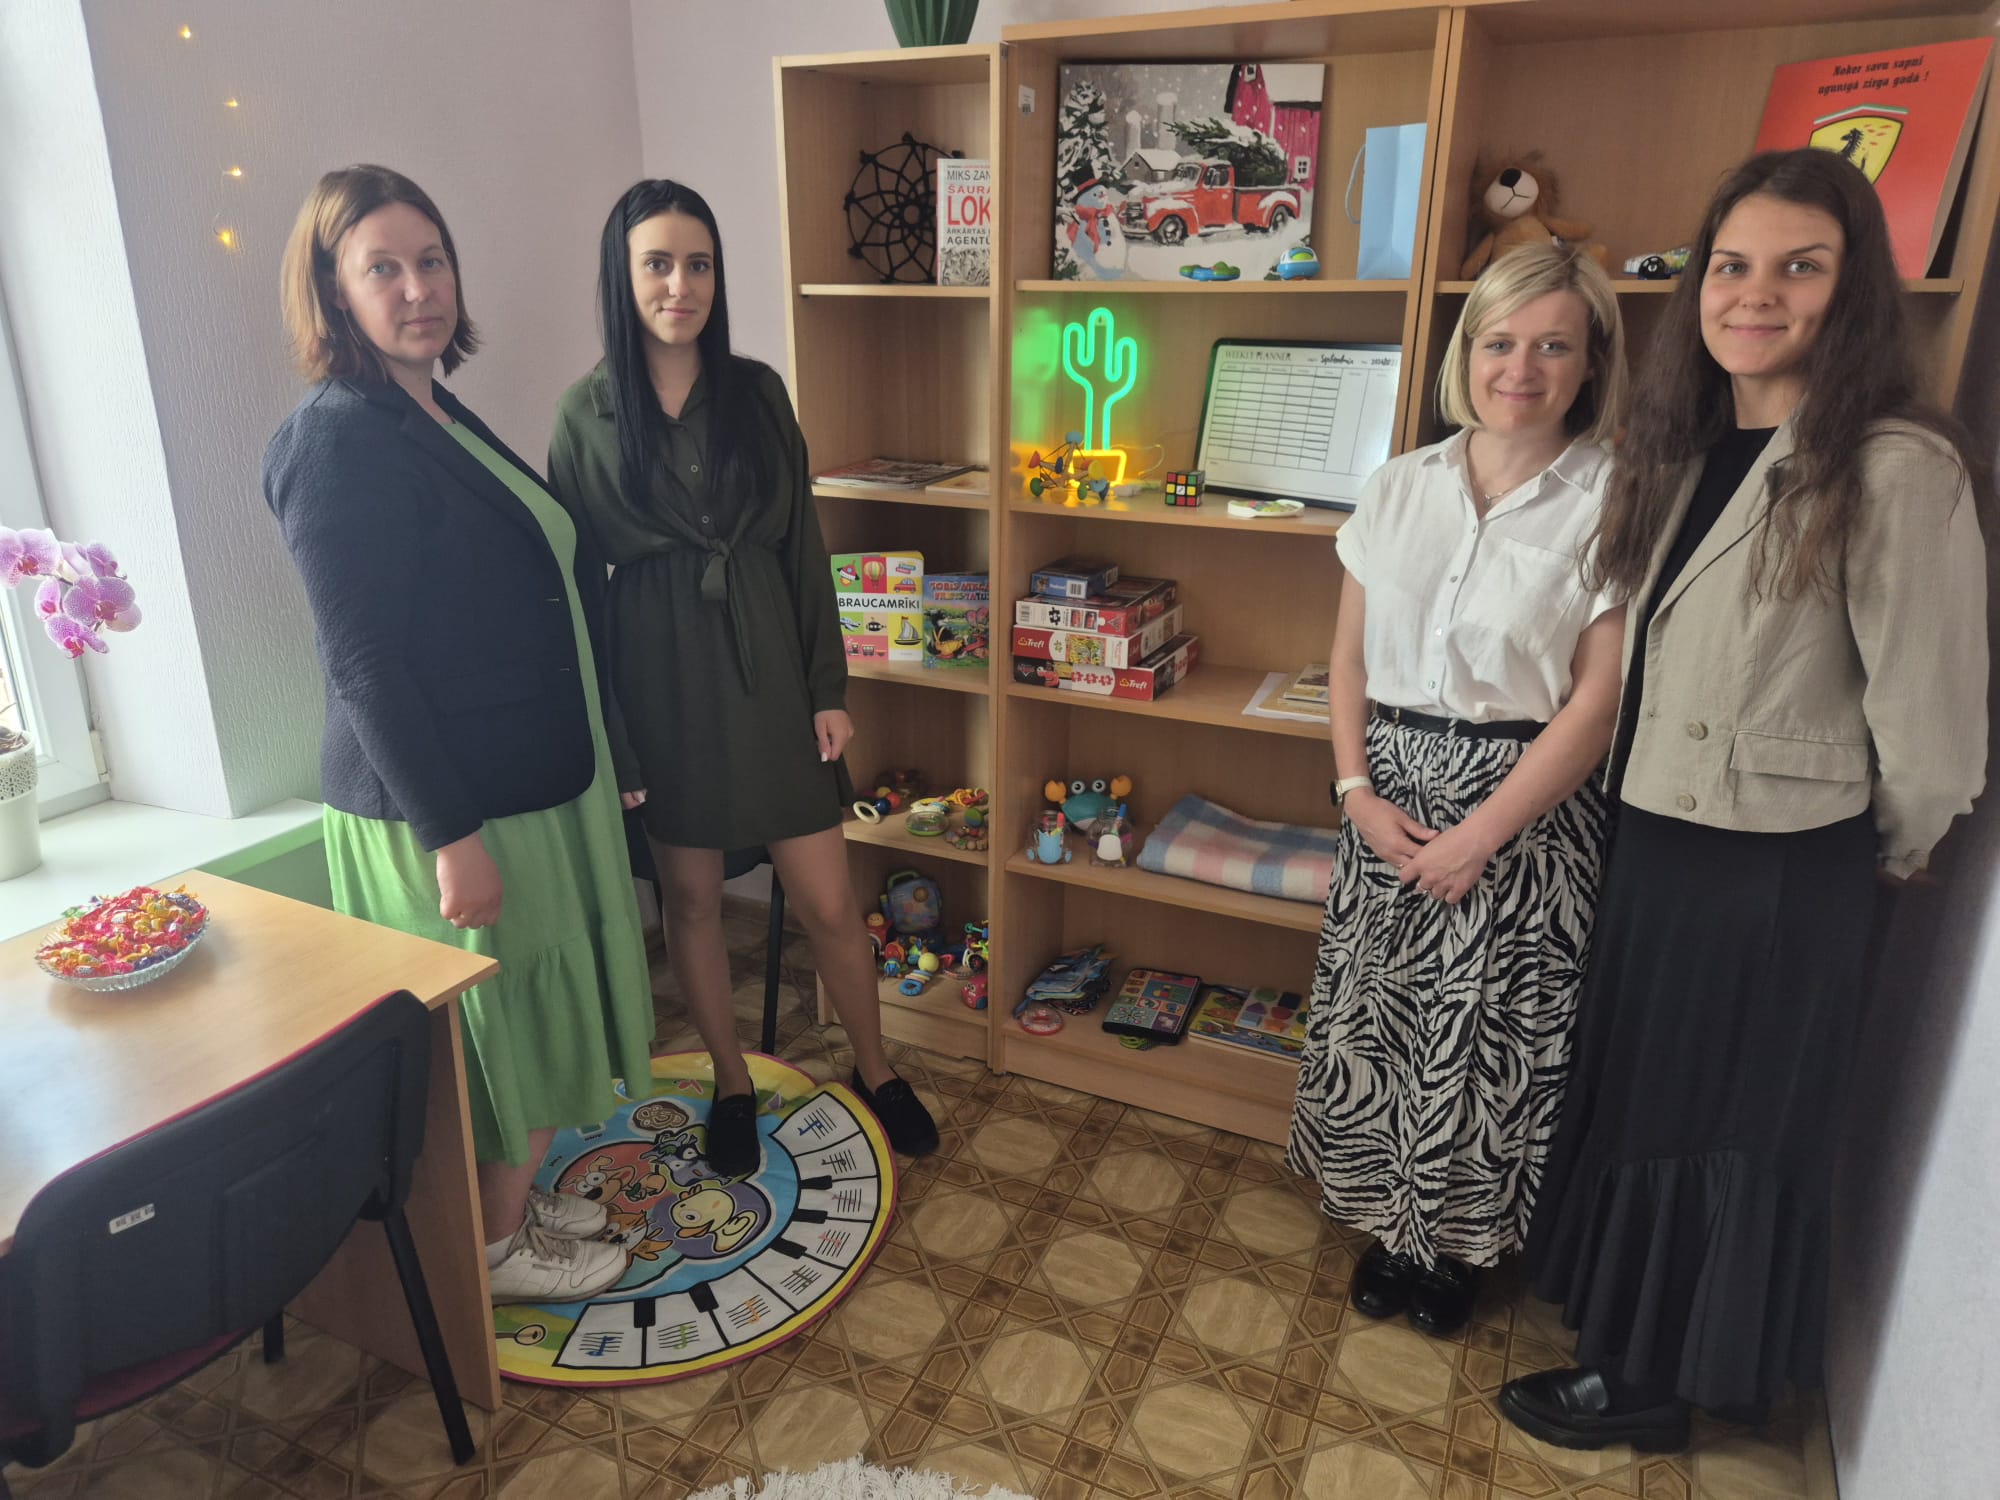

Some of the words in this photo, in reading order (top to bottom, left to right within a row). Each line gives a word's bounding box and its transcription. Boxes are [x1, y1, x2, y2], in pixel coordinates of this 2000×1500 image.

[947, 170, 971, 181] MIKS
[838, 596, 920, 610] BRAUCAMRĪKI
[1026, 637, 1045, 649] Trefl
[1128, 679, 1148, 690] Trefl
